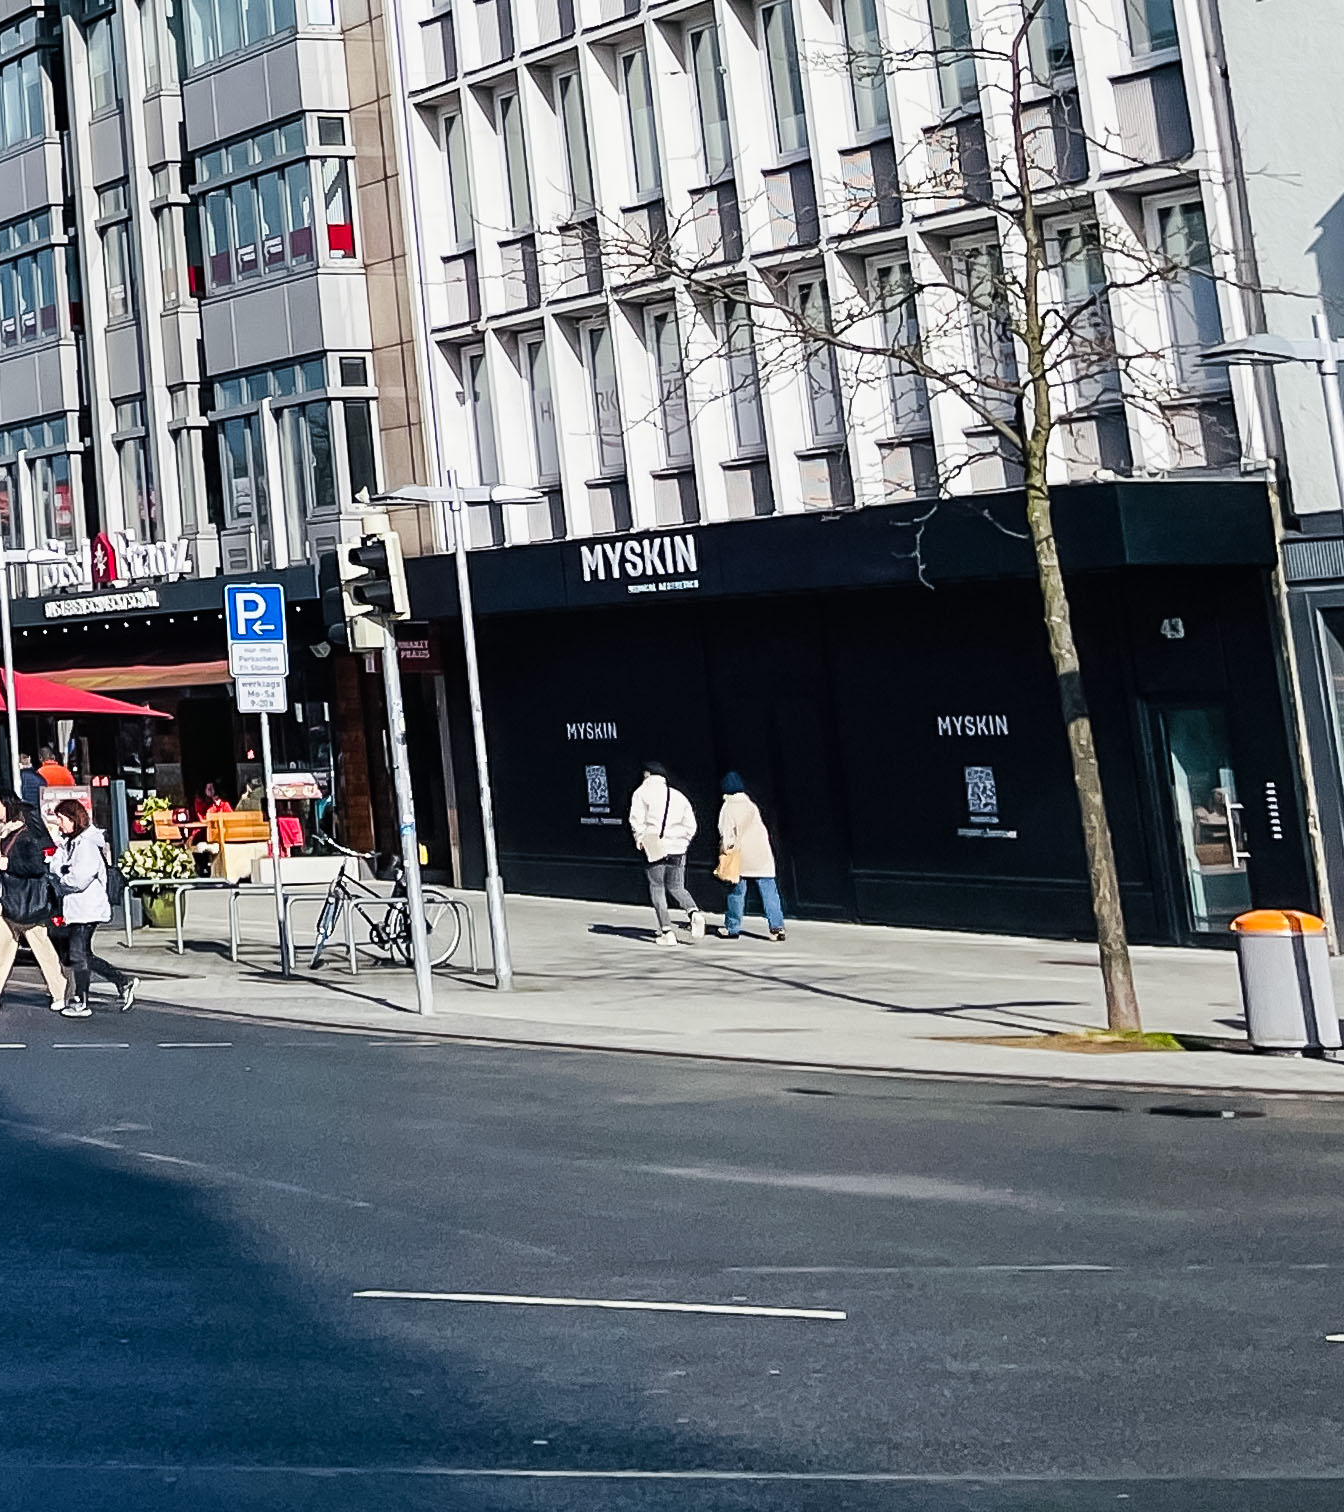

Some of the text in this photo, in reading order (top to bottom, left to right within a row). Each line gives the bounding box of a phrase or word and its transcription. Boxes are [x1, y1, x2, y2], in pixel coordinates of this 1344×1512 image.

[580, 534, 698, 582] MYSKIN
[235, 592, 267, 635] P
[566, 721, 618, 740] MYSKIN
[937, 714, 1009, 736] MYSKIN
